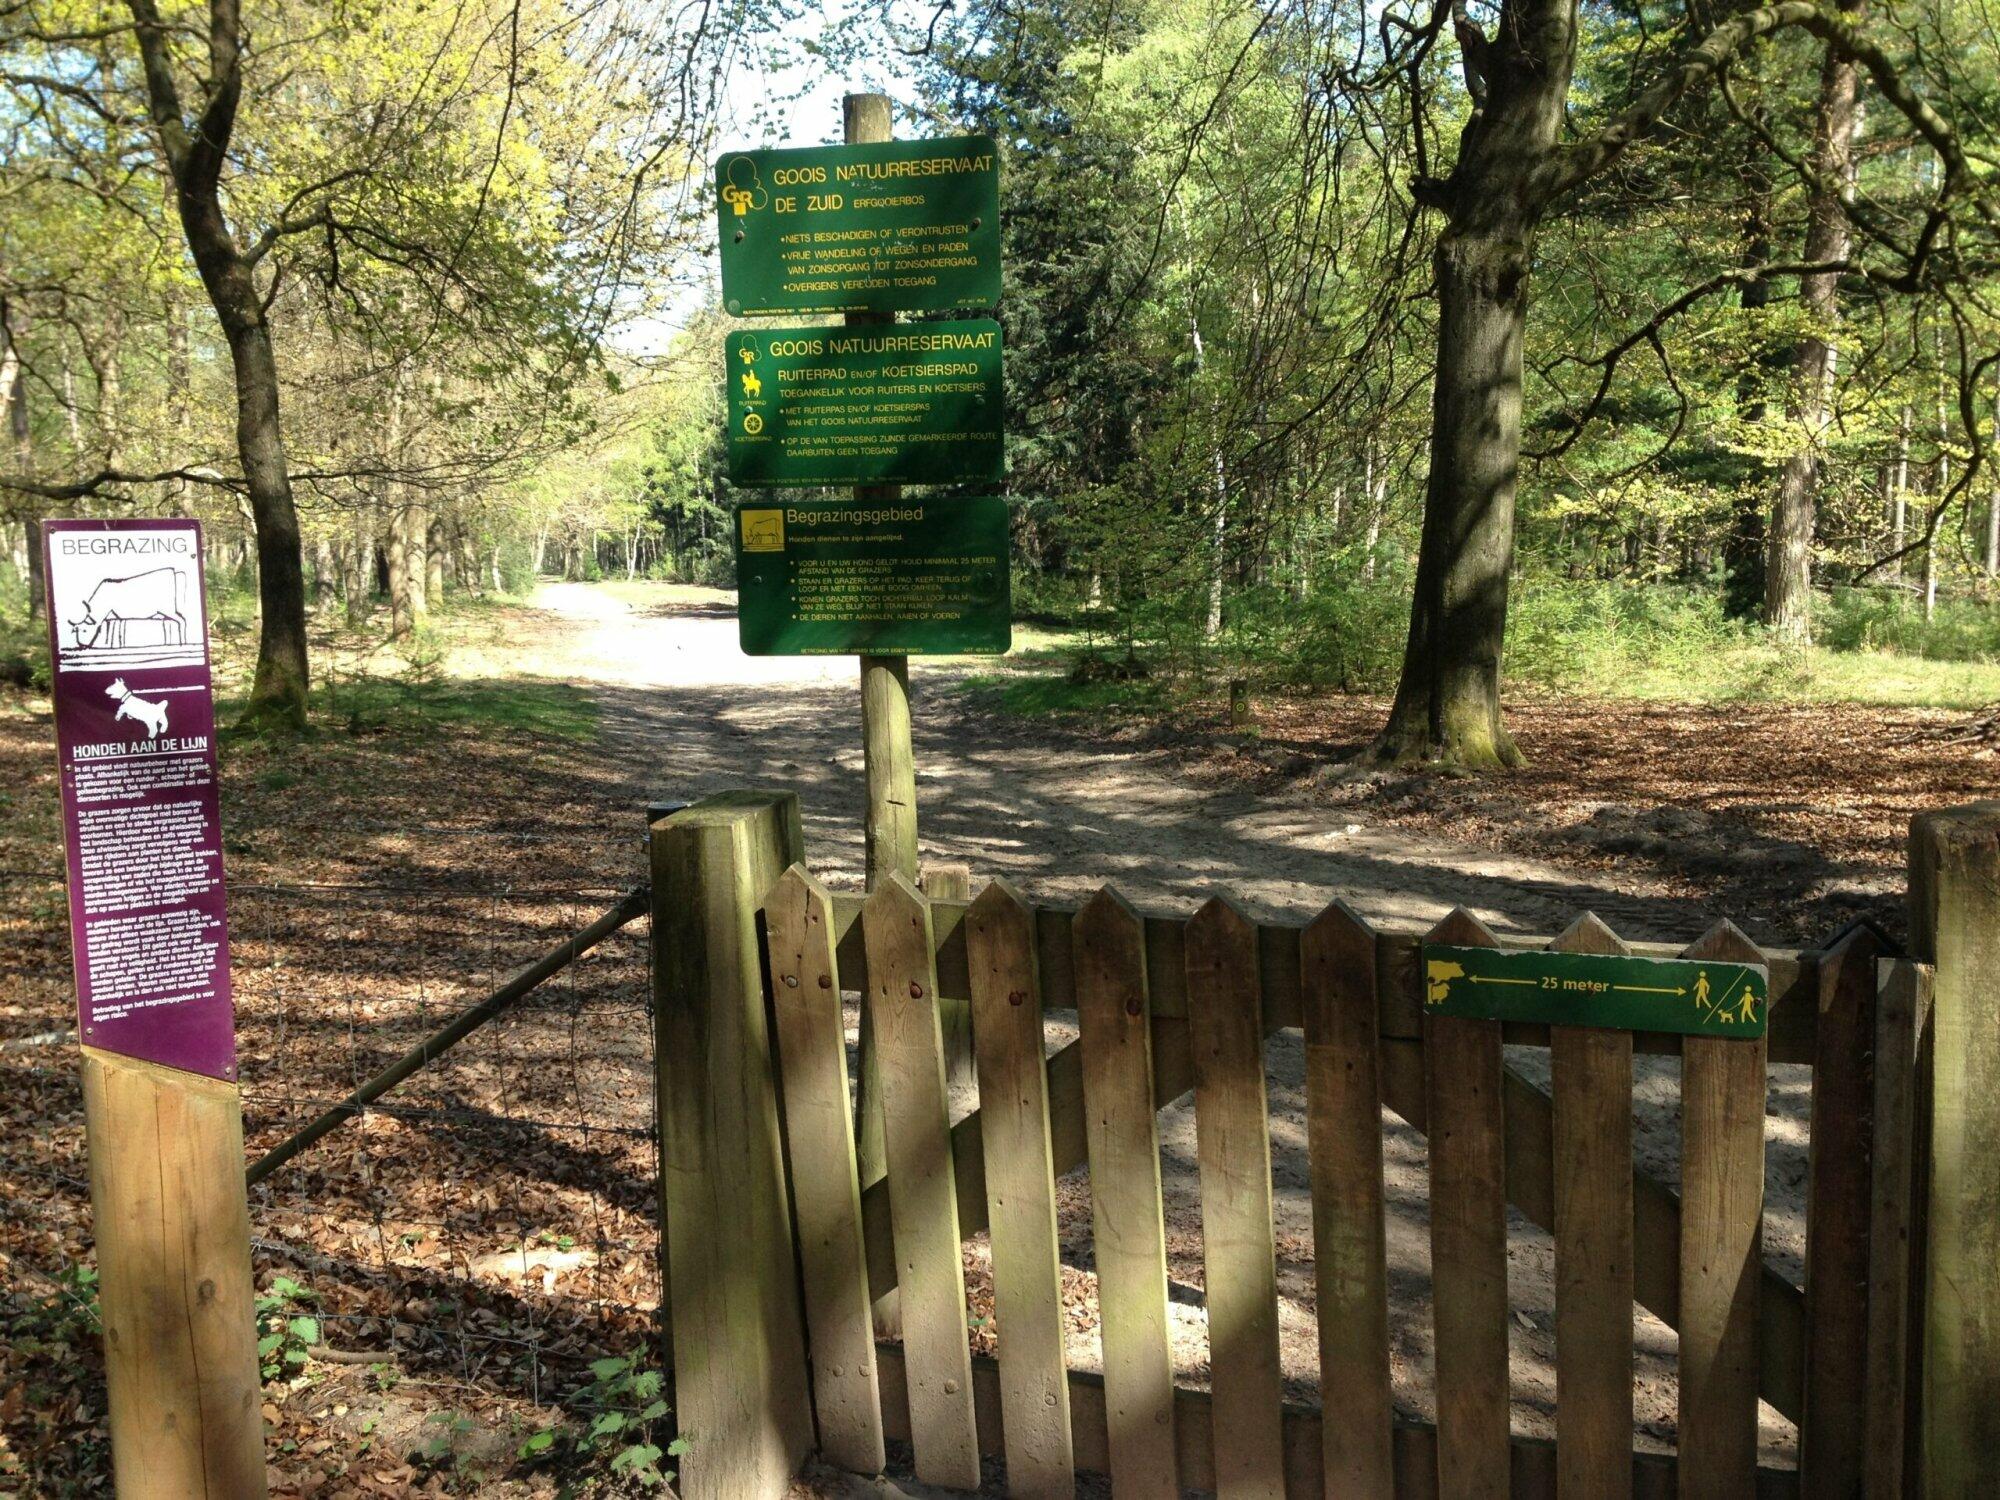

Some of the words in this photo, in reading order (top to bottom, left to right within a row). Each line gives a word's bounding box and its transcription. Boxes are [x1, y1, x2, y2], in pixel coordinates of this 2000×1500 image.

[774, 167, 826, 185] GOOIS
[836, 155, 993, 181] NATUURRESERVAAT
[775, 197, 796, 213] DE
[807, 194, 843, 211] ZUID
[853, 195, 925, 208] ERFGOOIERBOS
[786, 234, 810, 244] NIETS
[814, 230, 876, 242] BESCHADIGEN
[880, 229, 892, 239] OF
[896, 225, 968, 238] VERONTRUSTEN
[787, 250, 811, 260] VRIJE
[815, 248, 866, 260] WANDELING
[870, 246, 880, 256] OF
[885, 244, 918, 255] WEGEN
[922, 244, 934, 253] EN
[938, 242, 968, 252] PADEN
[788, 266, 805, 275] VAN
[808, 262, 870, 274] ZONSOPGANG
[874, 261, 890, 271] TOT
[895, 256, 978, 270] ZONSONDERGANG
[788, 281, 838, 292] OVERIGENS
[894, 276, 936, 287] TOEGANG
[770, 340, 823, 356] GOOIS
[830, 332, 996, 354] NATUURRESERVAAT
[778, 368, 847, 381] RUITERPAD
[850, 370, 878, 379] EN/OF
[882, 363, 978, 378] KOETSIERSPAD
[780, 388, 845, 398] TOEGANKELIJK
[848, 386, 874, 395] VOOR
[878, 384, 916, 395] RUITERS
[919, 384, 932, 393] EN
[804, 406, 845, 414] RUITERPAS
[874, 403, 930, 412] KOETSIERSPAS
[848, 415, 922, 425] NATUURRESERVAAT
[831, 436, 878, 444] TOEPASSING
[860, 447, 898, 455] TOEGANG
[786, 506, 923, 526] Begrazingsgebied
[62, 538, 188, 555] BEGRAZING
[72, 742, 126, 758] HONDEN
[130, 740, 156, 753] AAN
[161, 738, 177, 751] DE
[181, 736, 208, 750] LIJN
[92, 764, 112, 772] gebied
[1541, 976, 1558, 990] 25
[1563, 978, 1609, 993] meter
